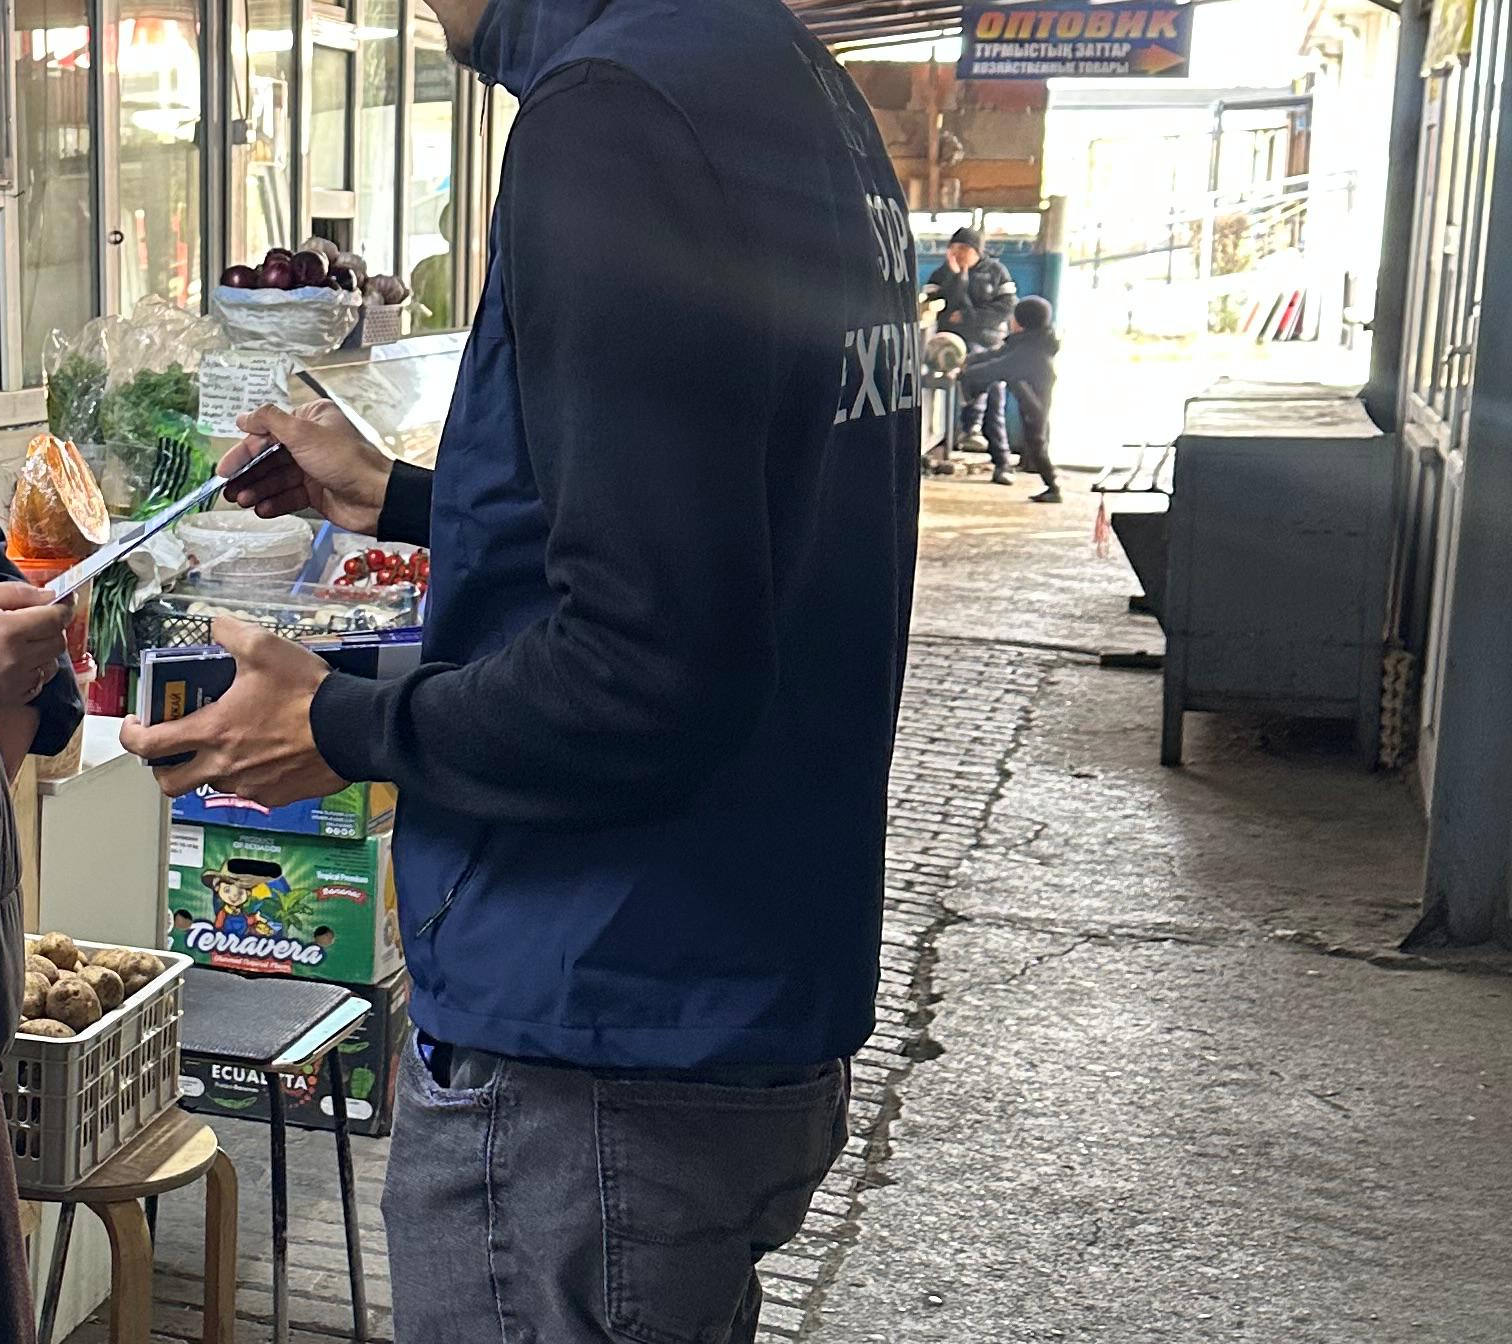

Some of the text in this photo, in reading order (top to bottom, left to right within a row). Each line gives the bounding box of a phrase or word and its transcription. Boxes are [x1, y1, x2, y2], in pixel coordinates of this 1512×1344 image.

[975, 10, 1179, 39] ОПТОВИК
[1076, 42, 1132, 58] ЗАТТАР
[1079, 60, 1130, 74] ТОВАРЫ
[187, 922, 323, 965] Terravera
